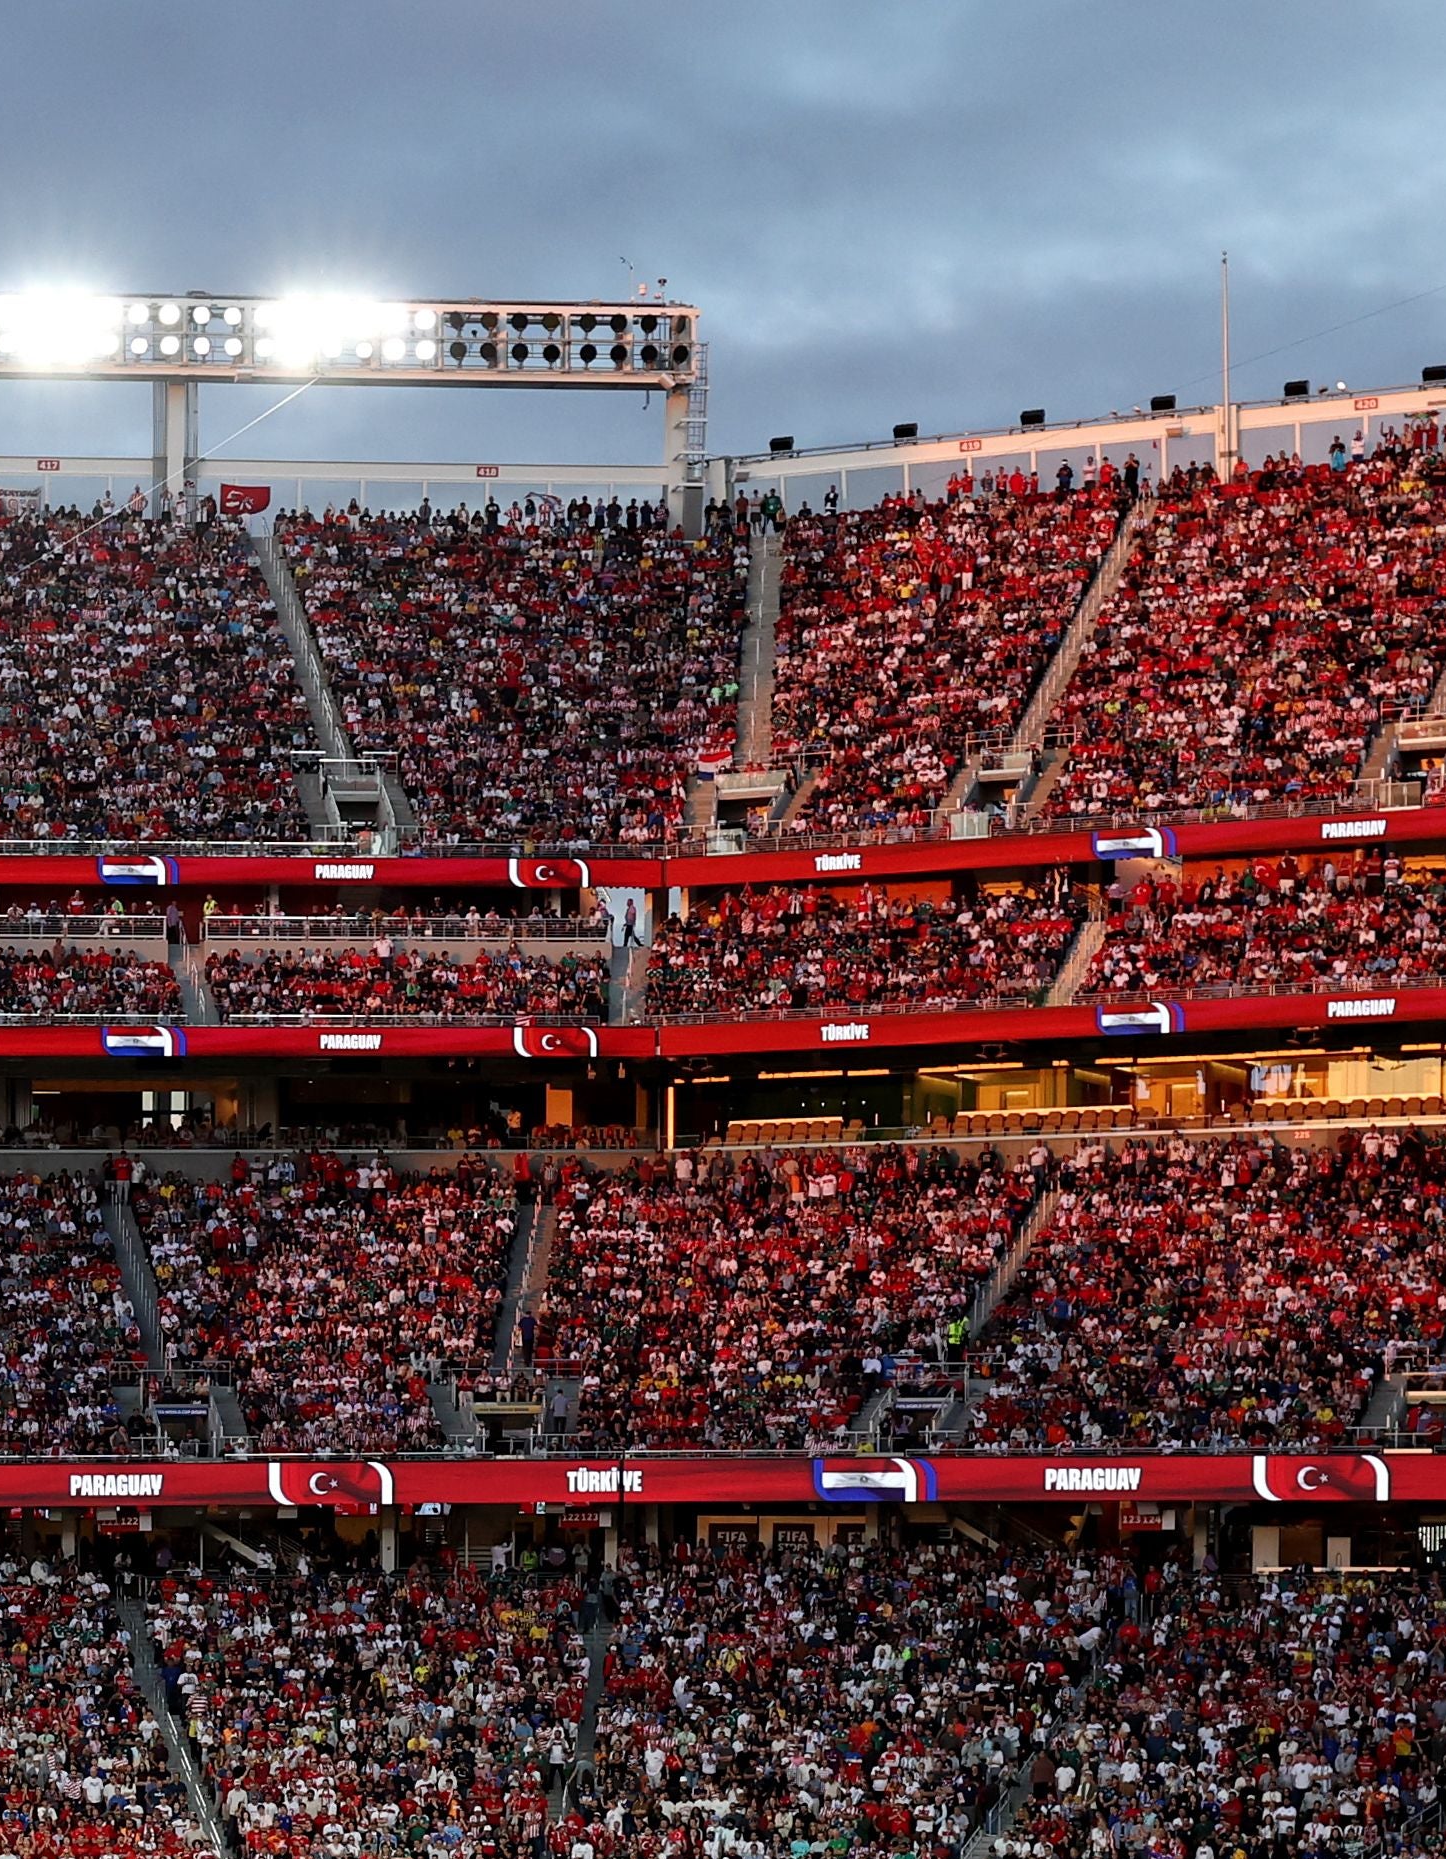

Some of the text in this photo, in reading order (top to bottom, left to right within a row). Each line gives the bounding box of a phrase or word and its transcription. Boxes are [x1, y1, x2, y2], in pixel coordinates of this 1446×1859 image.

[1356, 400, 1376, 409] 420
[961, 441, 980, 451] 419
[39, 461, 58, 469] 417
[478, 468, 497, 476] 418
[1322, 820, 1386, 838] PARAGUAY
[815, 853, 860, 871] TÜRKİYE
[316, 865, 373, 879] PARAGUAY
[1328, 999, 1395, 1017] PARAGUAY
[821, 1023, 868, 1041] TÜRKİYE
[320, 1035, 381, 1049] PARAGUAY
[71, 1475, 162, 1496] PARAGUAY
[567, 1467, 642, 1492] TÜRKİYE
[1045, 1468, 1141, 1490] PARAGUAY
[562, 1513, 598, 1521] 122 123
[1122, 1515, 1161, 1523] 123 124
[778, 1531, 808, 1542] FIFA
